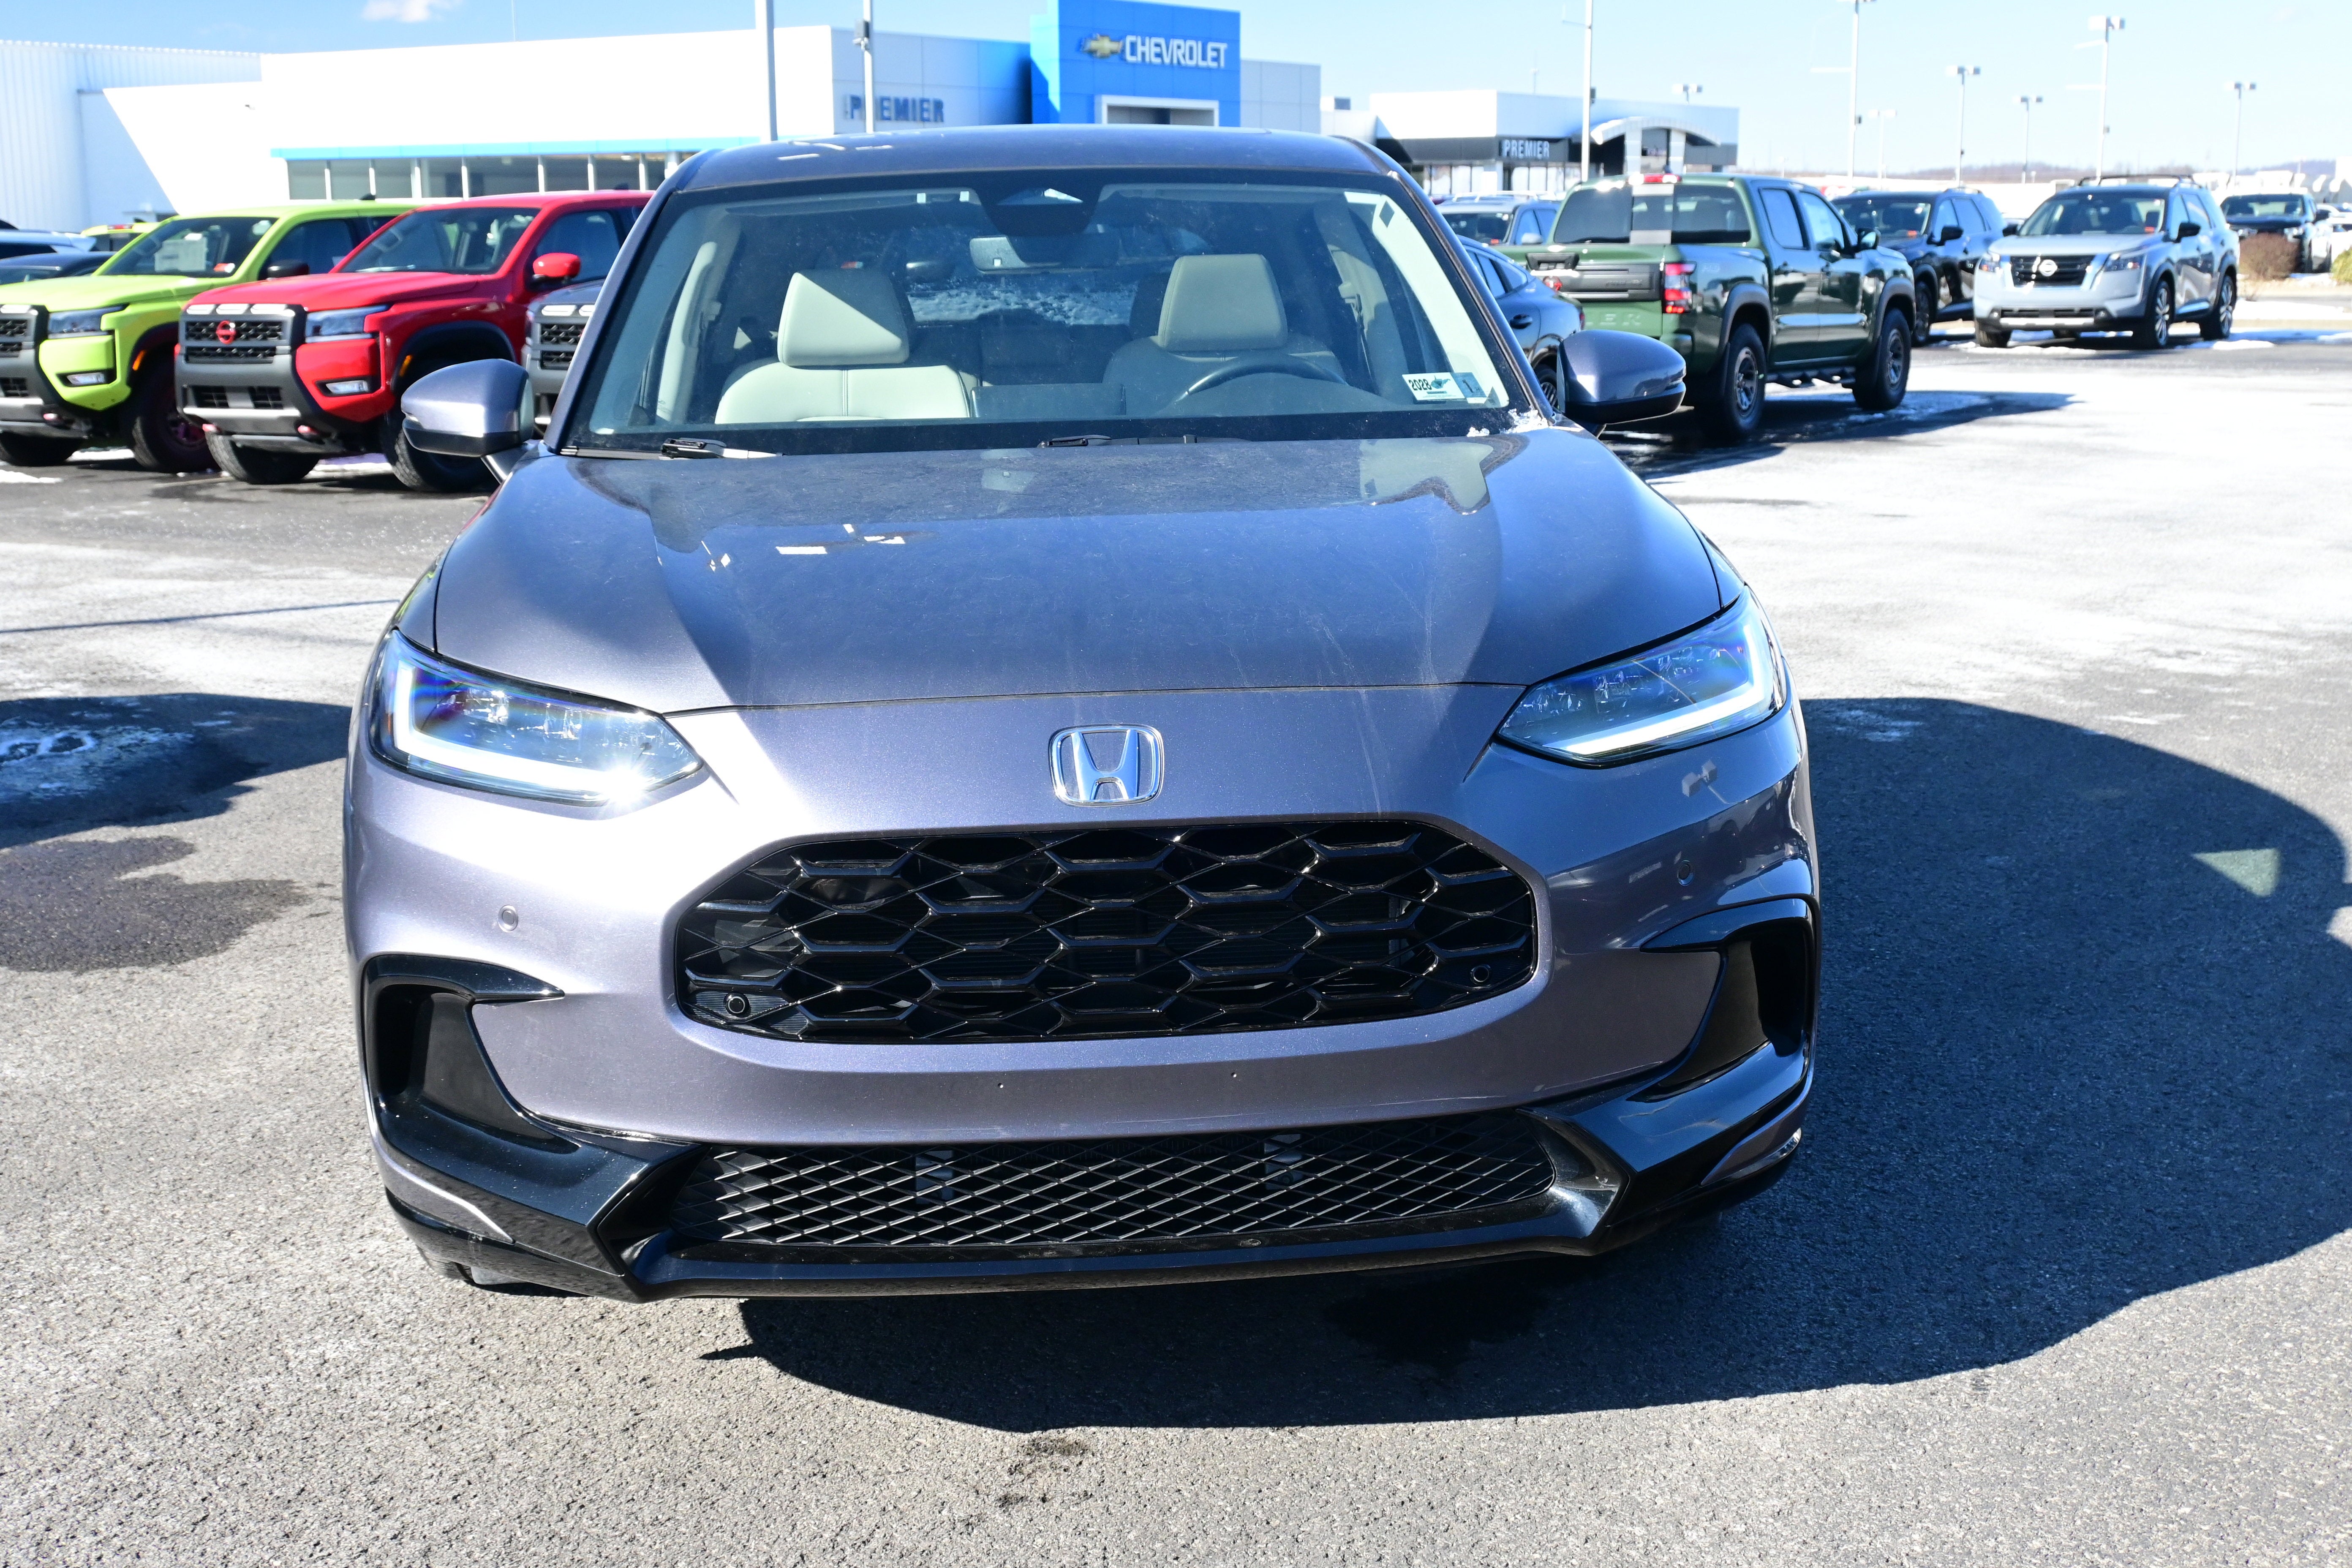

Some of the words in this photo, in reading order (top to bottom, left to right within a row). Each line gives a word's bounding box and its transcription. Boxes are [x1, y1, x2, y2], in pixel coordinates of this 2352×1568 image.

[1125, 35, 1228, 68] CHEVROLET
[847, 94, 944, 122] PEMIER
[1502, 139, 1550, 159] PREMIER
[1408, 378, 1432, 391] 2028
